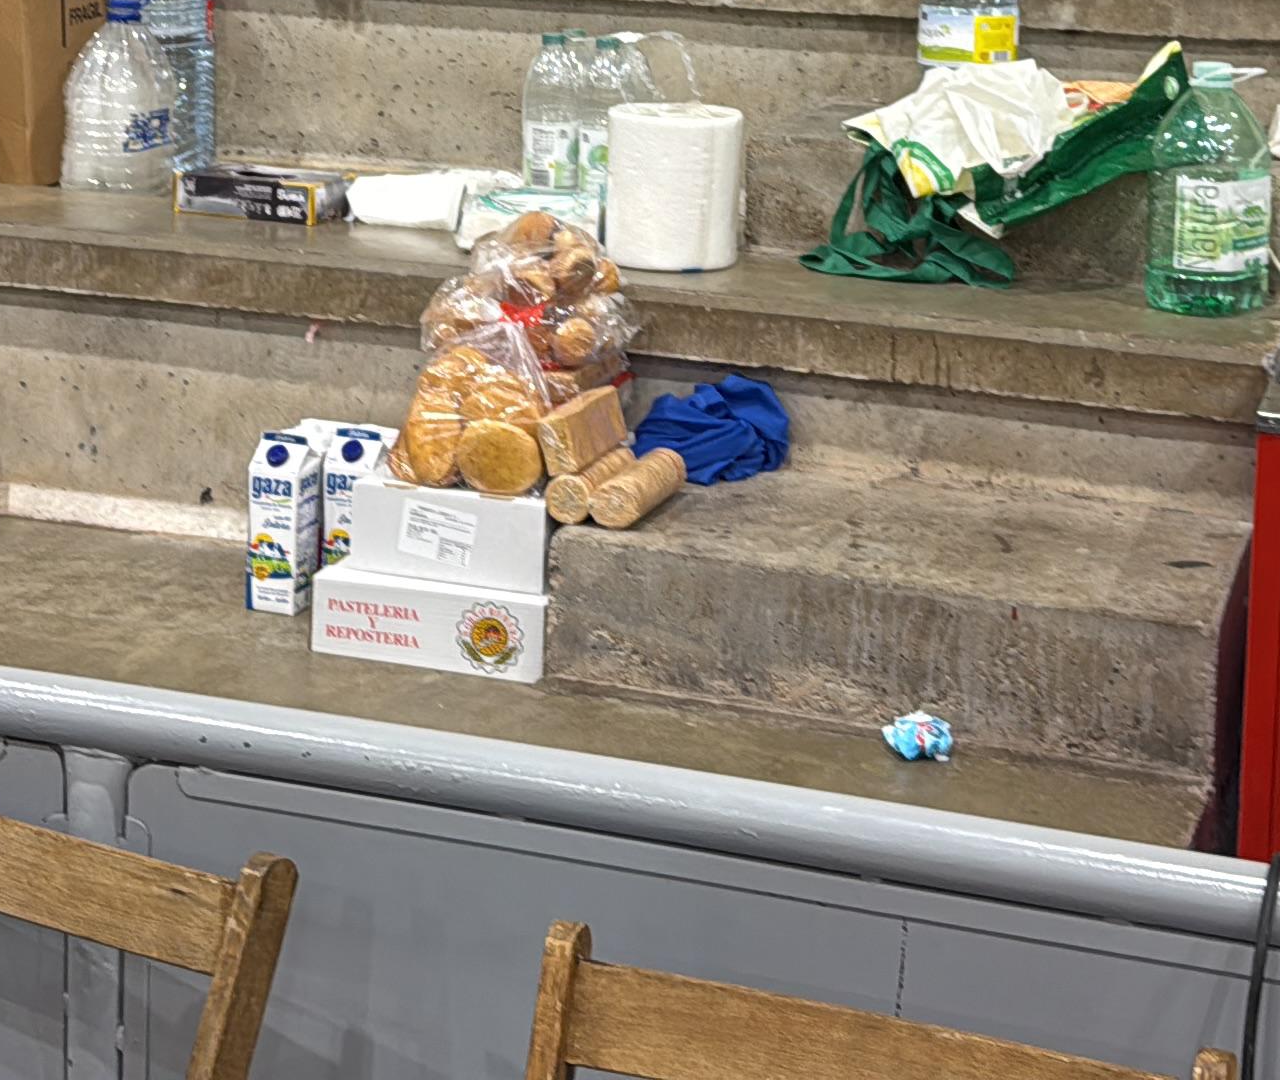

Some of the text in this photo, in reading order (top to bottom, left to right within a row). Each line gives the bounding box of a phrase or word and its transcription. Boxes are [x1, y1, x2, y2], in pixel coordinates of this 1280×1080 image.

[1183, 185, 1219, 270] Natura
[252, 475, 292, 498] gaza
[328, 598, 419, 620] PASTELERIA
[368, 616, 378, 629] Y
[326, 624, 419, 648] REPOSTERIA
